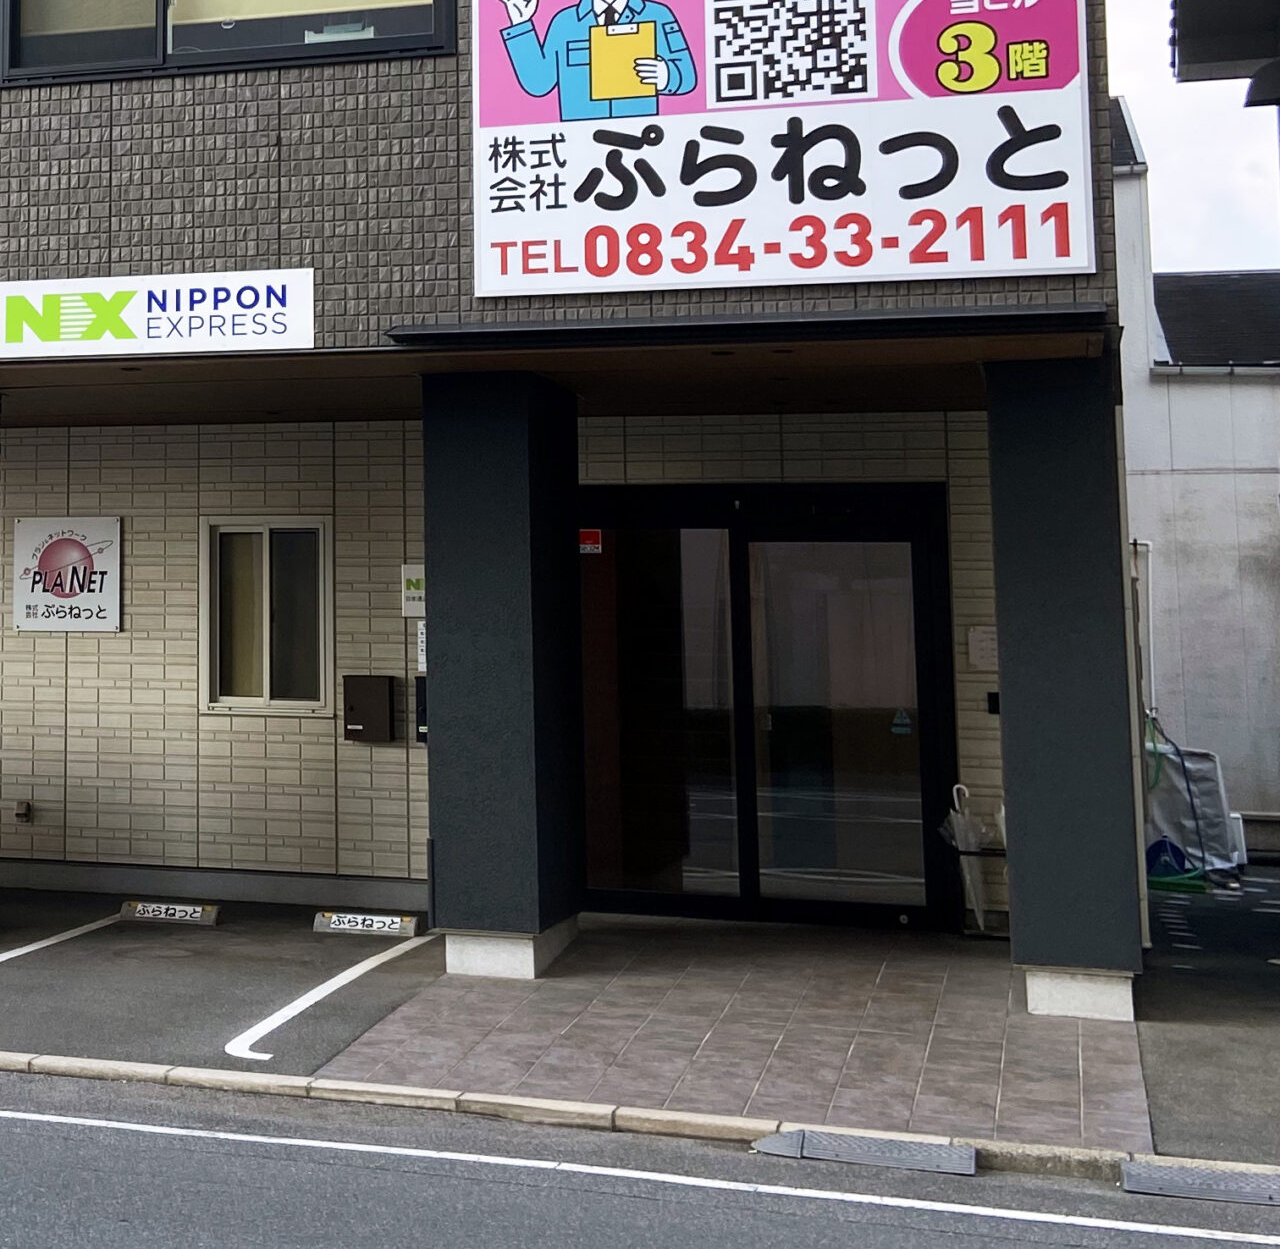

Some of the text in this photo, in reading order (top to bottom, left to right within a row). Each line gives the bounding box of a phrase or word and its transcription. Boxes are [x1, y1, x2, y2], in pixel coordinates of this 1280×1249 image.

[936, 21, 1049, 93] 3階
[573, 105, 1070, 211] ぷらねっと
[147, 284, 288, 313] NIPPON
[146, 312, 288, 339] EXPRESS
[30, 566, 108, 593] PLANET
[41, 604, 108, 620] ぷらねっと
